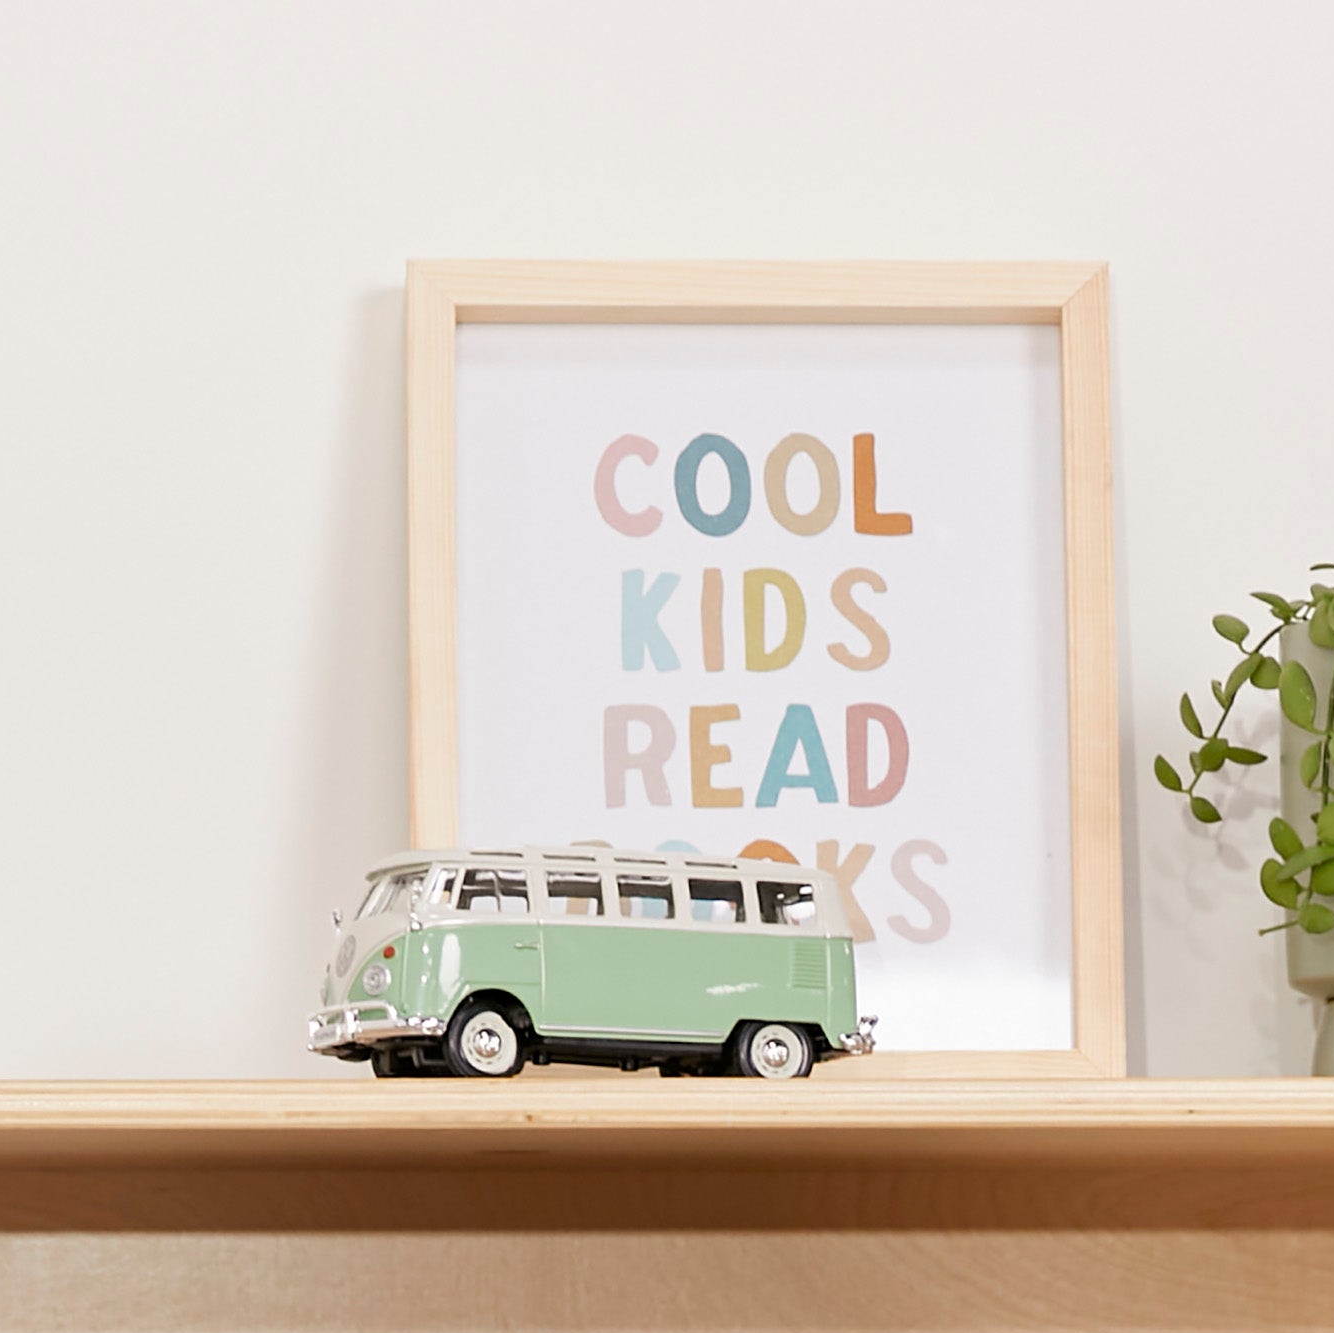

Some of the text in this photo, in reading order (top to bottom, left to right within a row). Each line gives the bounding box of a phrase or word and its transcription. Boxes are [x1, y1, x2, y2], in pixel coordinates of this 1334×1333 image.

[593, 432, 913, 538] COOL
[620, 566, 892, 673] KIDS
[602, 702, 910, 809] READ
